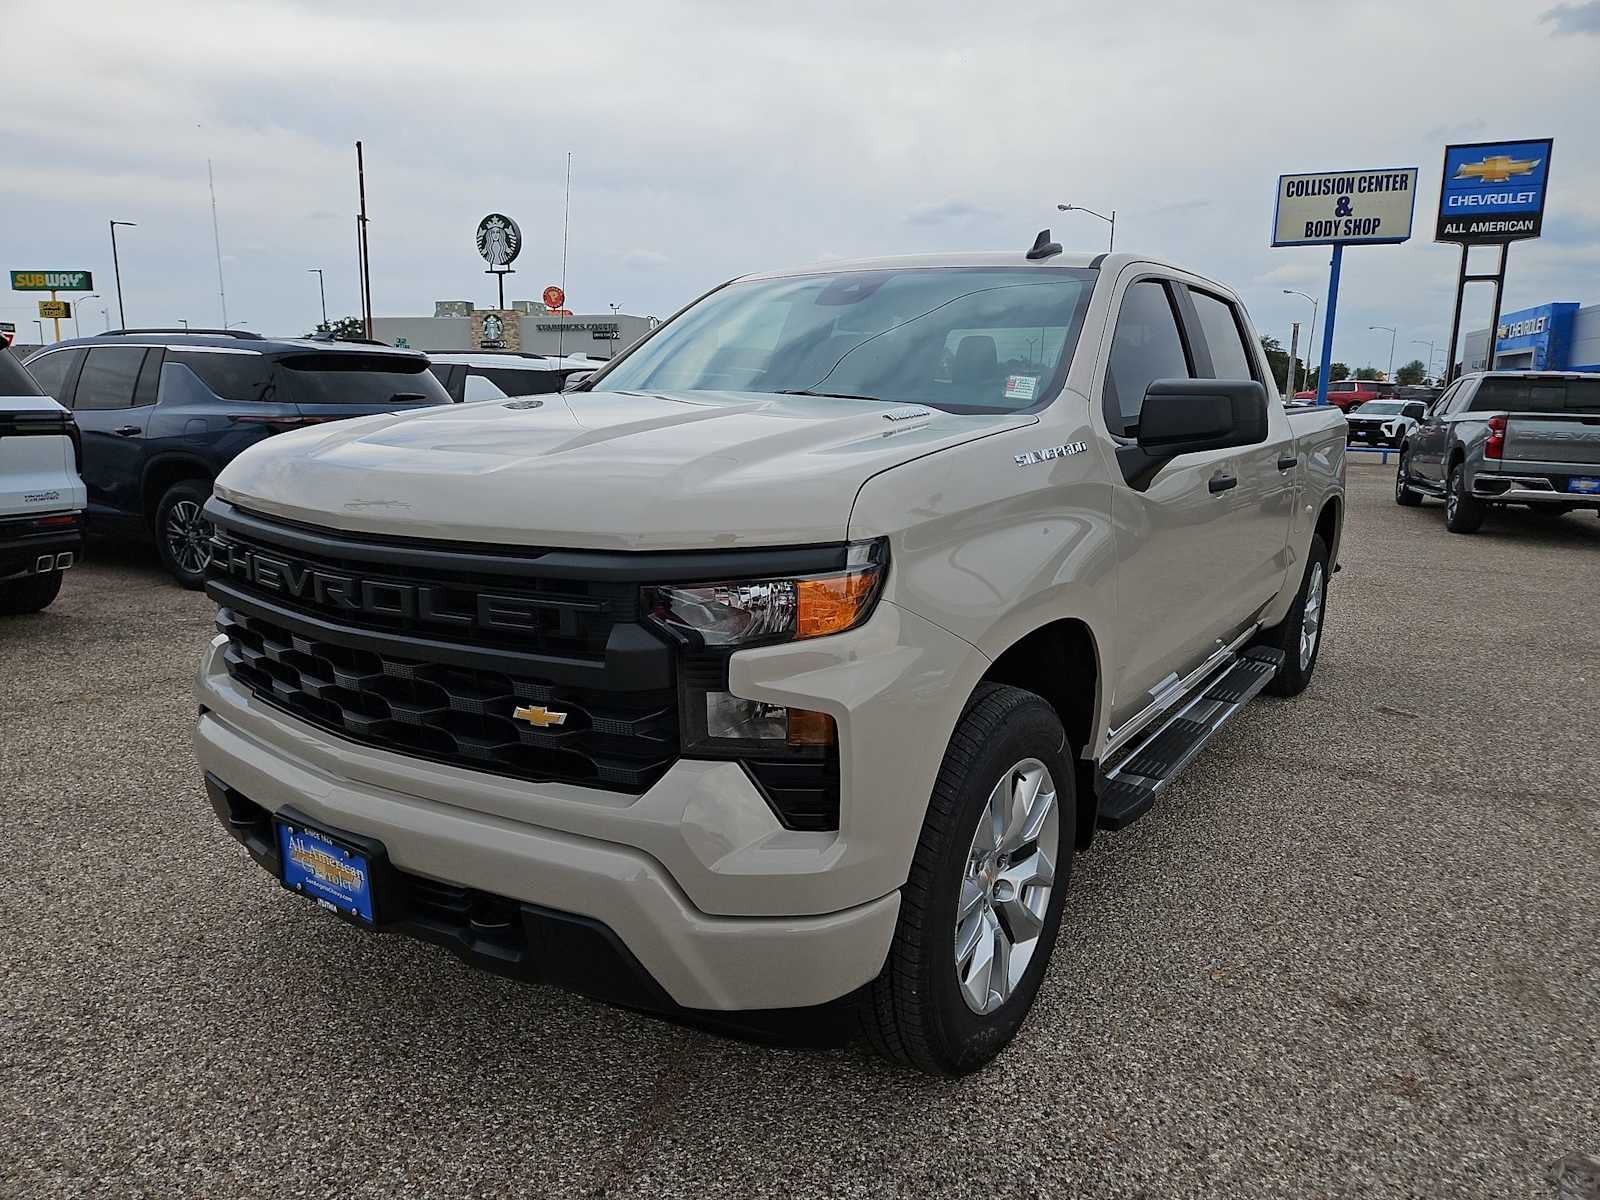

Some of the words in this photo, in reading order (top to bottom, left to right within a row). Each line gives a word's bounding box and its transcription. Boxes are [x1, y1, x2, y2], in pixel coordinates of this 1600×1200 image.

[1286, 177, 1354, 198] COLLISION
[1358, 173, 1409, 194] CENTER
[1335, 195, 1353, 218] &
[1448, 191, 1537, 207] CHEVROLET
[1304, 219, 1341, 238] BODY
[1343, 217, 1381, 236] SHOP
[1444, 223, 1466, 234] ALL
[1470, 220, 1533, 233] AMERICAN
[15, 273, 84, 288] SUBWAY
[1508, 316, 1546, 339] CHEVROLET
[1014, 441, 1088, 467] SILVERADO
[208, 536, 608, 640] CHEVROLET
